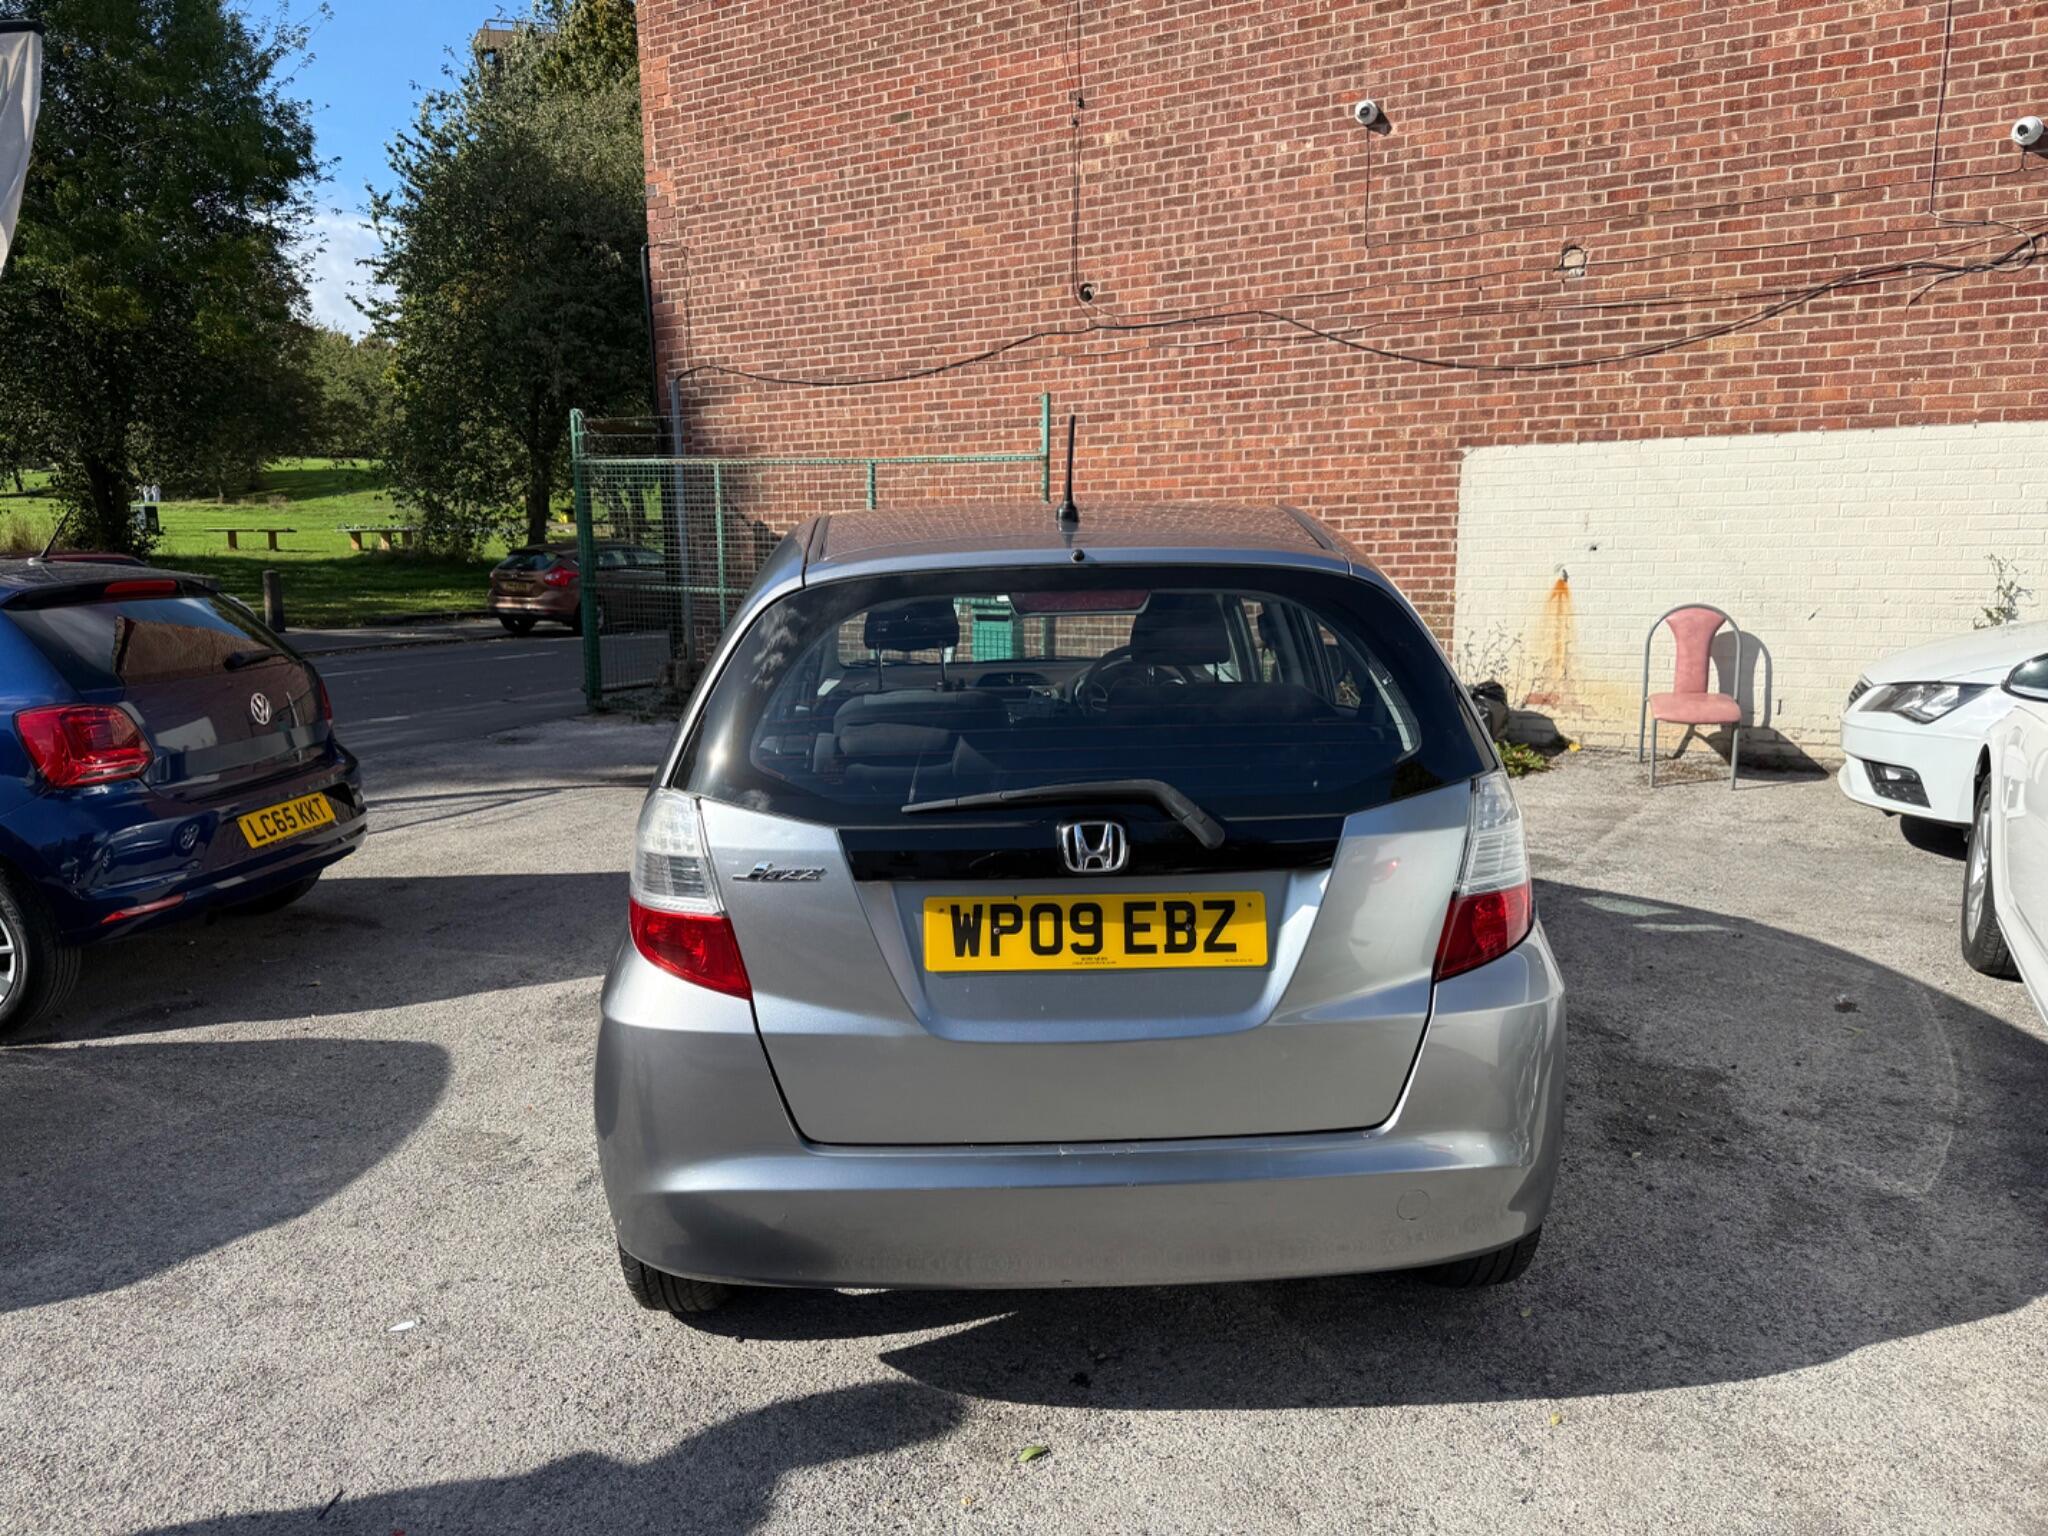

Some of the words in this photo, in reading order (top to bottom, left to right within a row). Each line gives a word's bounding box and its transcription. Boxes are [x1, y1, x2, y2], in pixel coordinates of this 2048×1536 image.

[246, 807, 298, 842] LC65
[294, 797, 327, 825] KKT
[732, 861, 828, 881] Jazz
[950, 902, 1104, 957] WP09
[1123, 900, 1237, 955] EBZ
